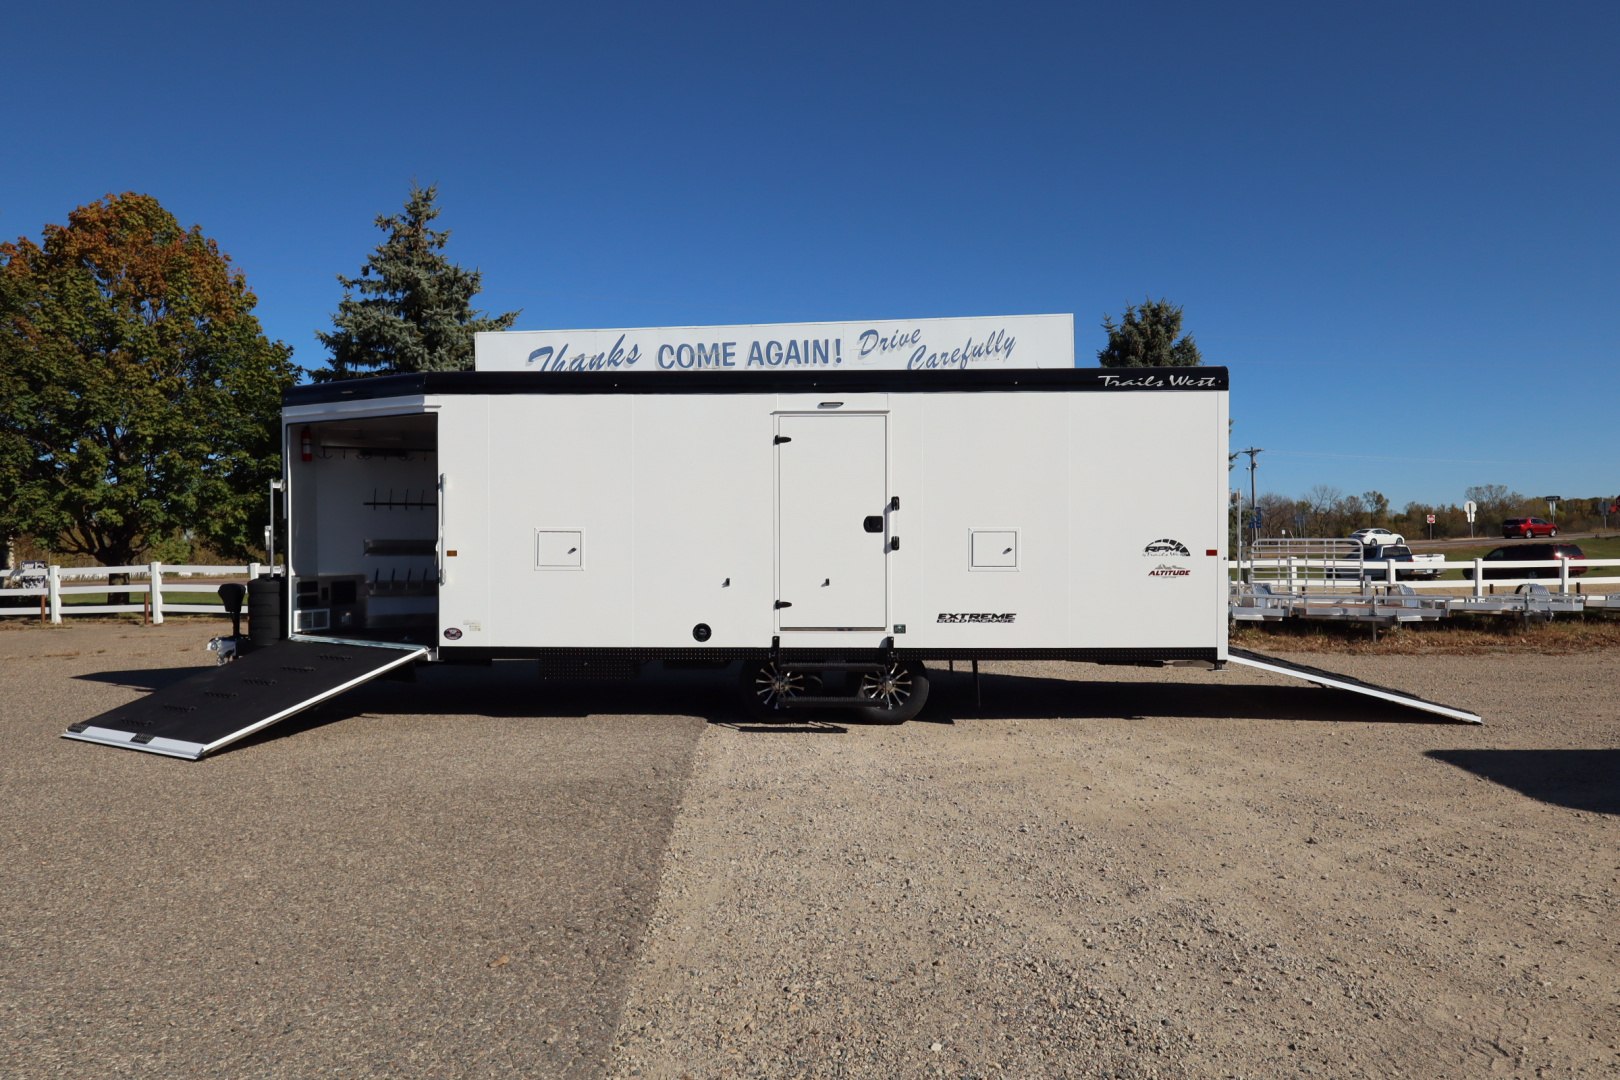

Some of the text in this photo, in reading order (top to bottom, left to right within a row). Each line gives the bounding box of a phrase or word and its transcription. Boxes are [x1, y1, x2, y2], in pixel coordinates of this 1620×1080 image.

[528, 334, 642, 371] Thanks
[658, 338, 842, 369] COME AGAIN!
[859, 329, 922, 356] Drive
[907, 328, 1015, 370] Carefully
[1097, 374, 1216, 387] Trails West
